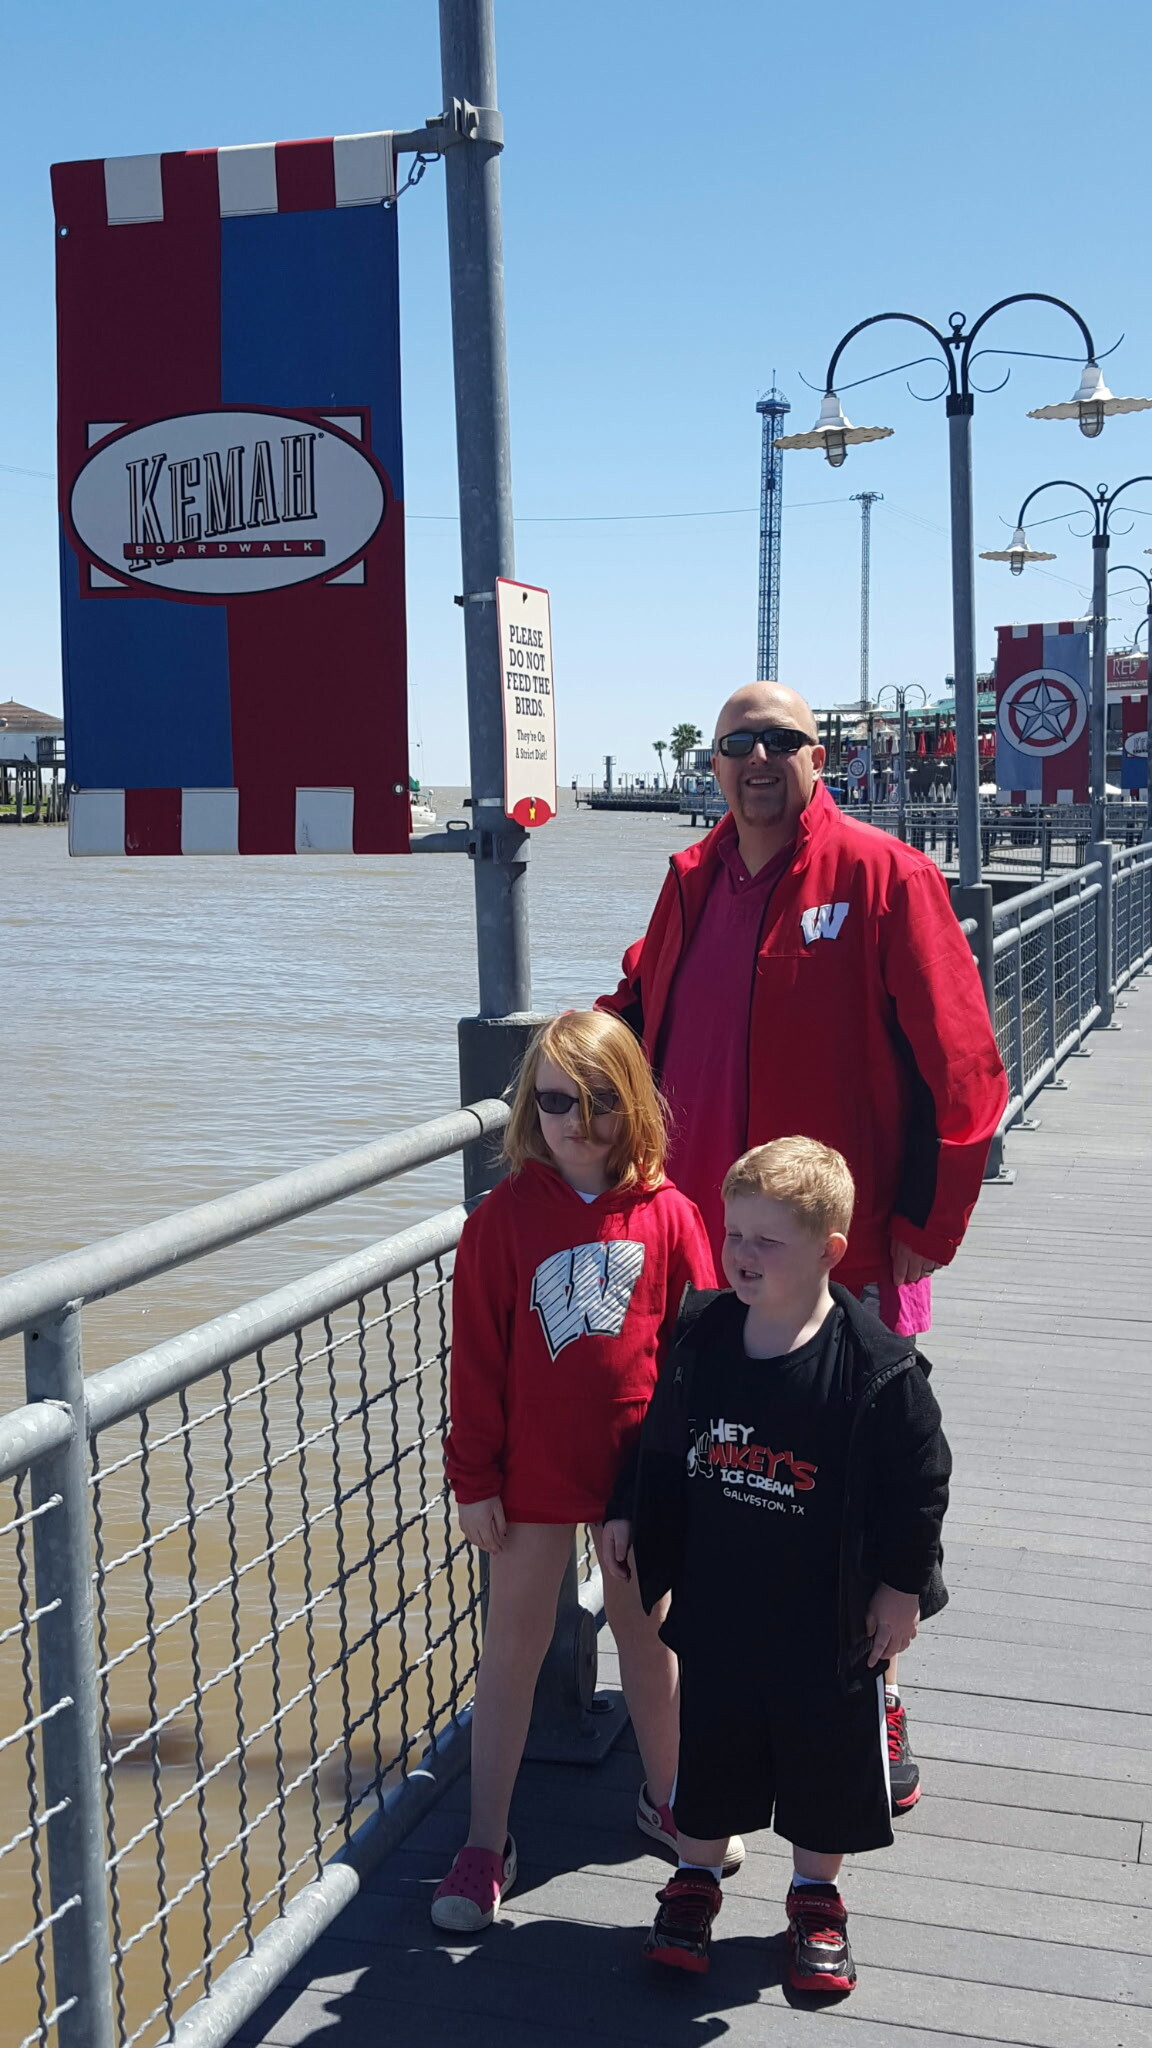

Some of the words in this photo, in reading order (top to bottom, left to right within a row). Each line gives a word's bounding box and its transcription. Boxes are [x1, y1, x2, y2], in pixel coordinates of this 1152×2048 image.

[126, 433, 318, 572] KEMAH
[135, 542, 313, 555] BOARDWALK
[509, 624, 544, 648] PLEASE
[509, 648, 524, 668] DO
[526, 651, 546, 671] NOT
[506, 671, 532, 692] FEED
[532, 675, 551, 695] THE
[514, 696, 546, 718] BIRDS.
[516, 728, 537, 744] They're
[537, 731, 546, 742] On
[515, 747, 520, 759] A
[520, 748, 535, 760] Strict
[535, 749, 548, 760] Diet!
[800, 902, 850, 947] W
[529, 1240, 645, 1363] W
[710, 1418, 755, 1444] HEY
[707, 1442, 818, 1491] MIKEY'S
[720, 1468, 745, 1484] ICE
[746, 1473, 795, 1498] CREAM
[722, 1487, 787, 1513] GALVESTON,
[790, 1504, 805, 1516] TX
